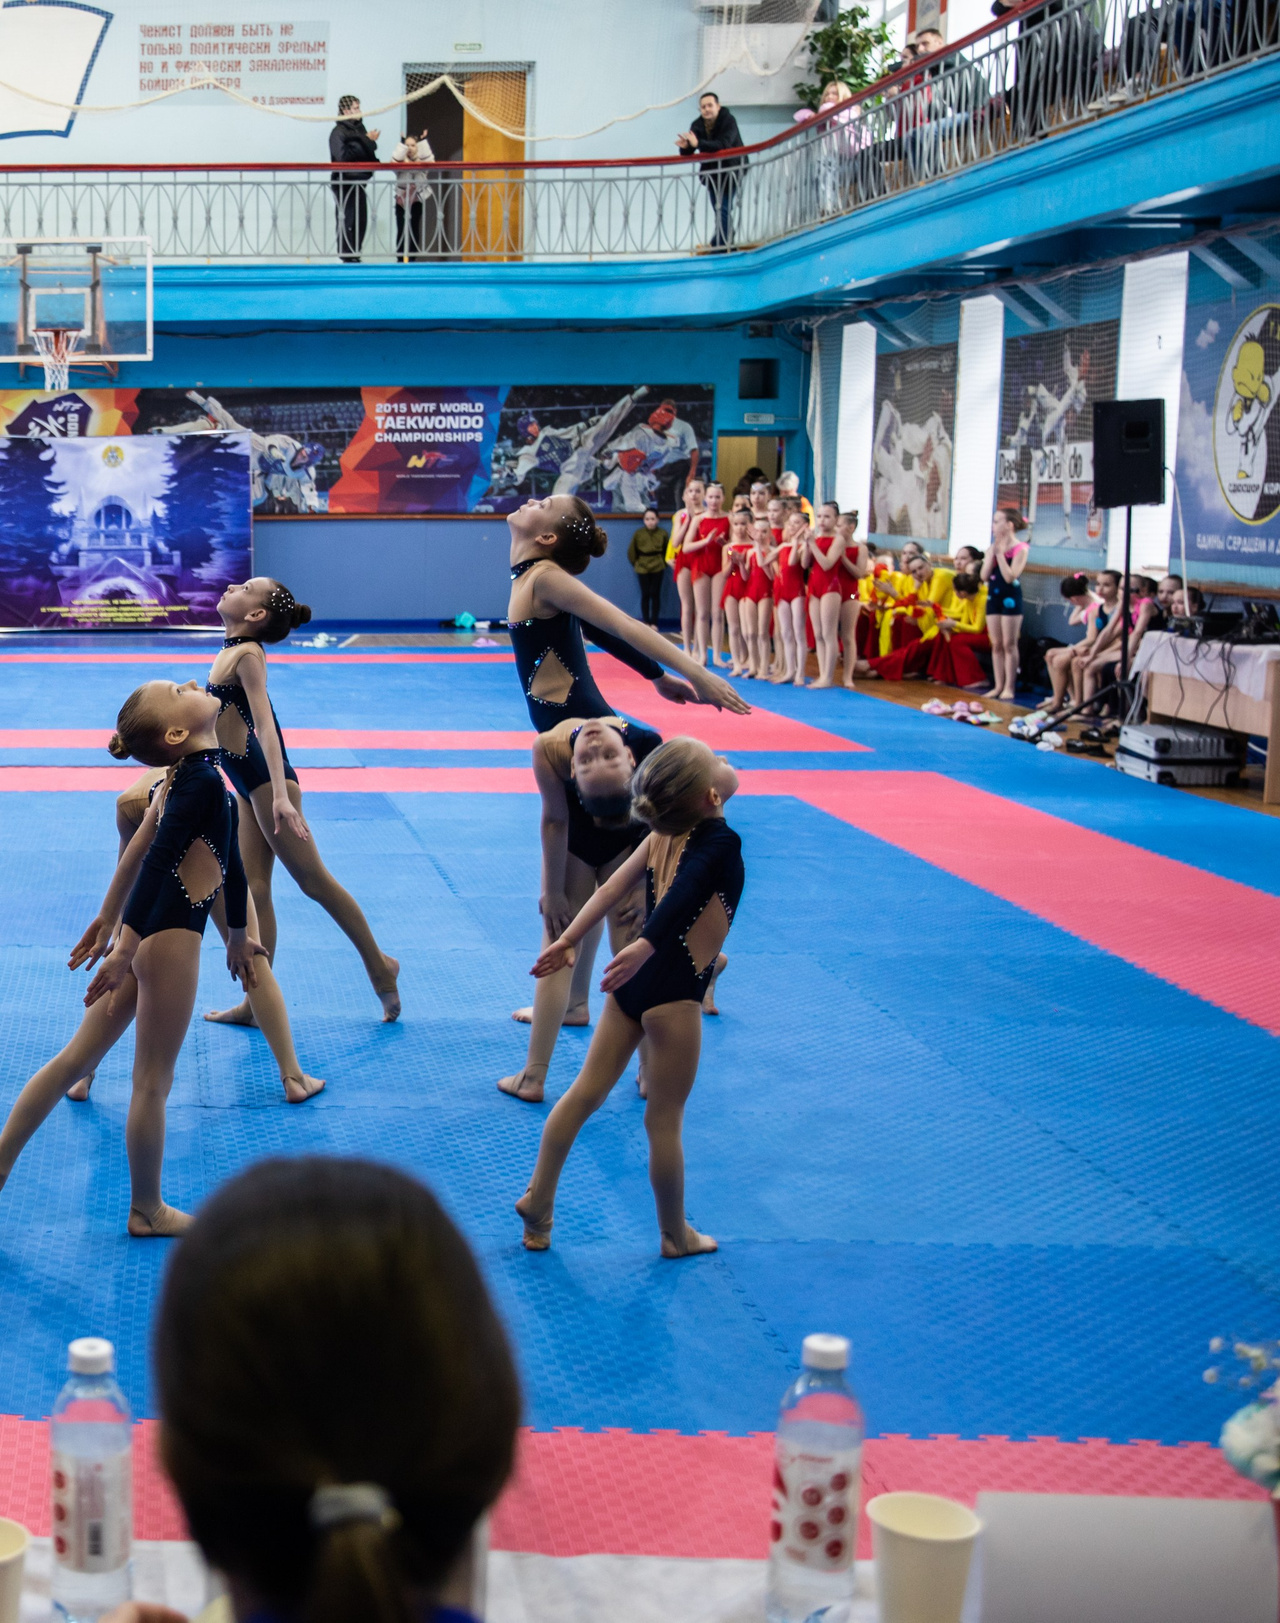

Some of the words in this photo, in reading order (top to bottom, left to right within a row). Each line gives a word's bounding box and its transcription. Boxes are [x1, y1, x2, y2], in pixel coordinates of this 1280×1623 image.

[375, 403, 407, 414] 2015
[410, 403, 437, 413] WTF
[439, 402, 484, 413] WORLD
[375, 415, 484, 430] TAEKWONDO
[375, 432, 483, 443] CHAMPIONSHIPS
